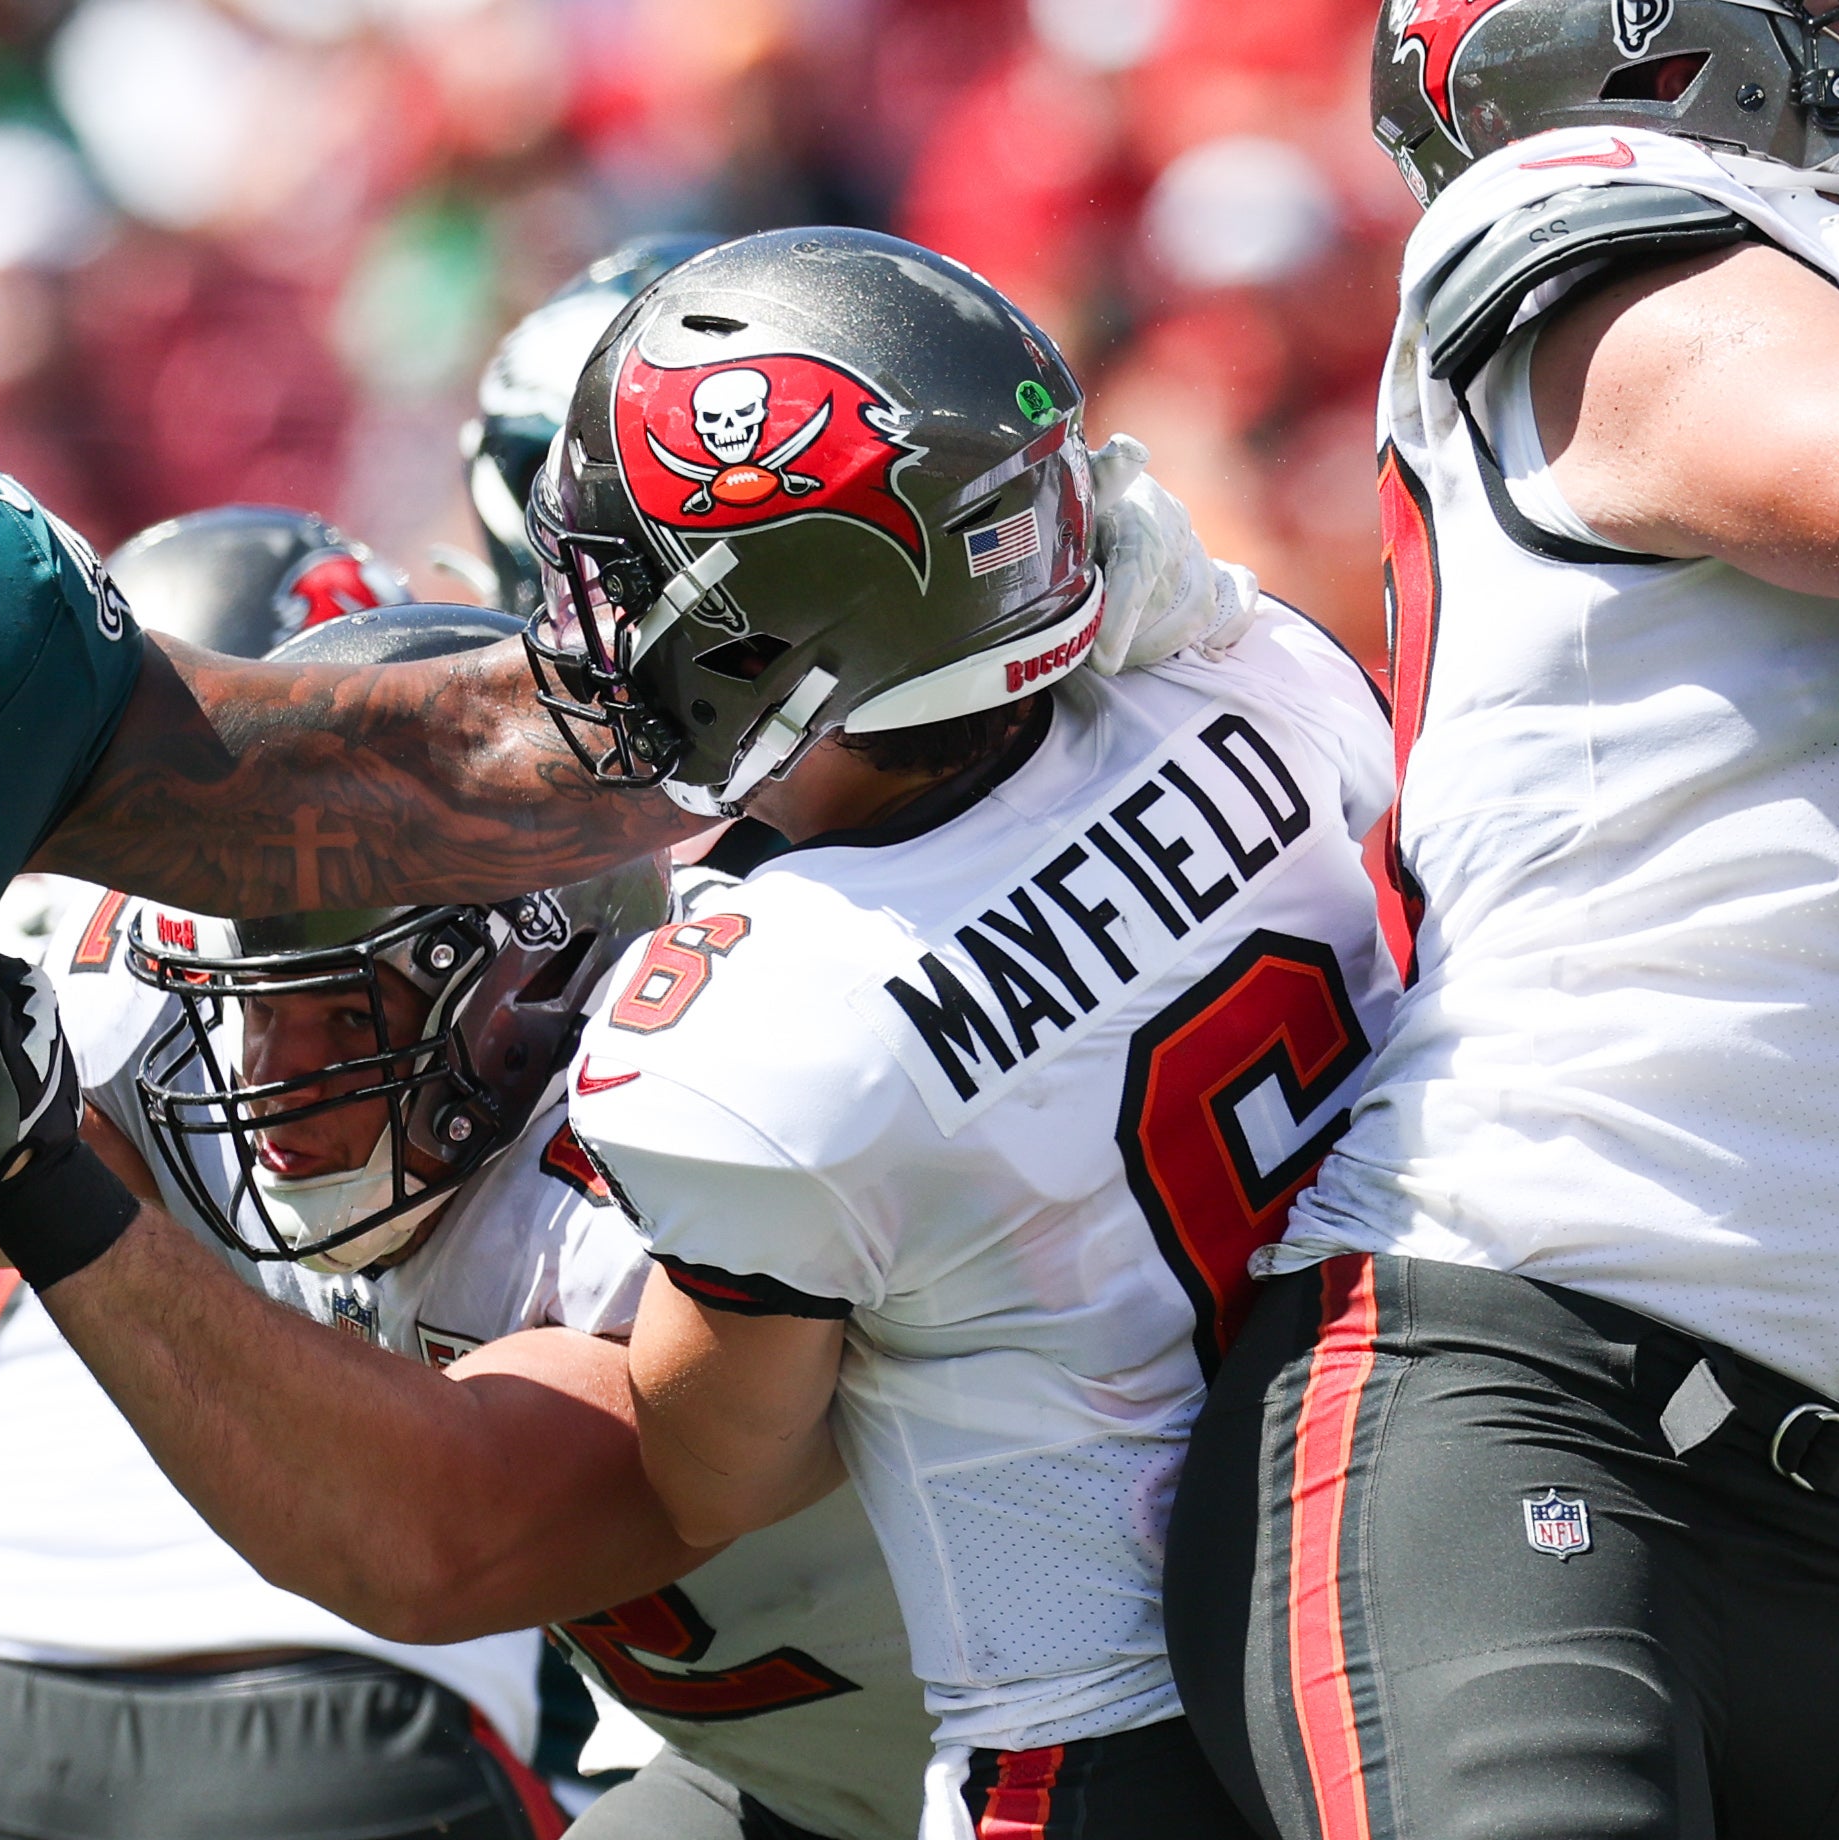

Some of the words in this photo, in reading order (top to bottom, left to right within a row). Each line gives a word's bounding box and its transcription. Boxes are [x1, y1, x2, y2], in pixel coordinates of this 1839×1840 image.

[884, 713, 1311, 1103] MAYFIELD
[608, 913, 752, 1036] 6
[1538, 1521, 1583, 1546] NFL
